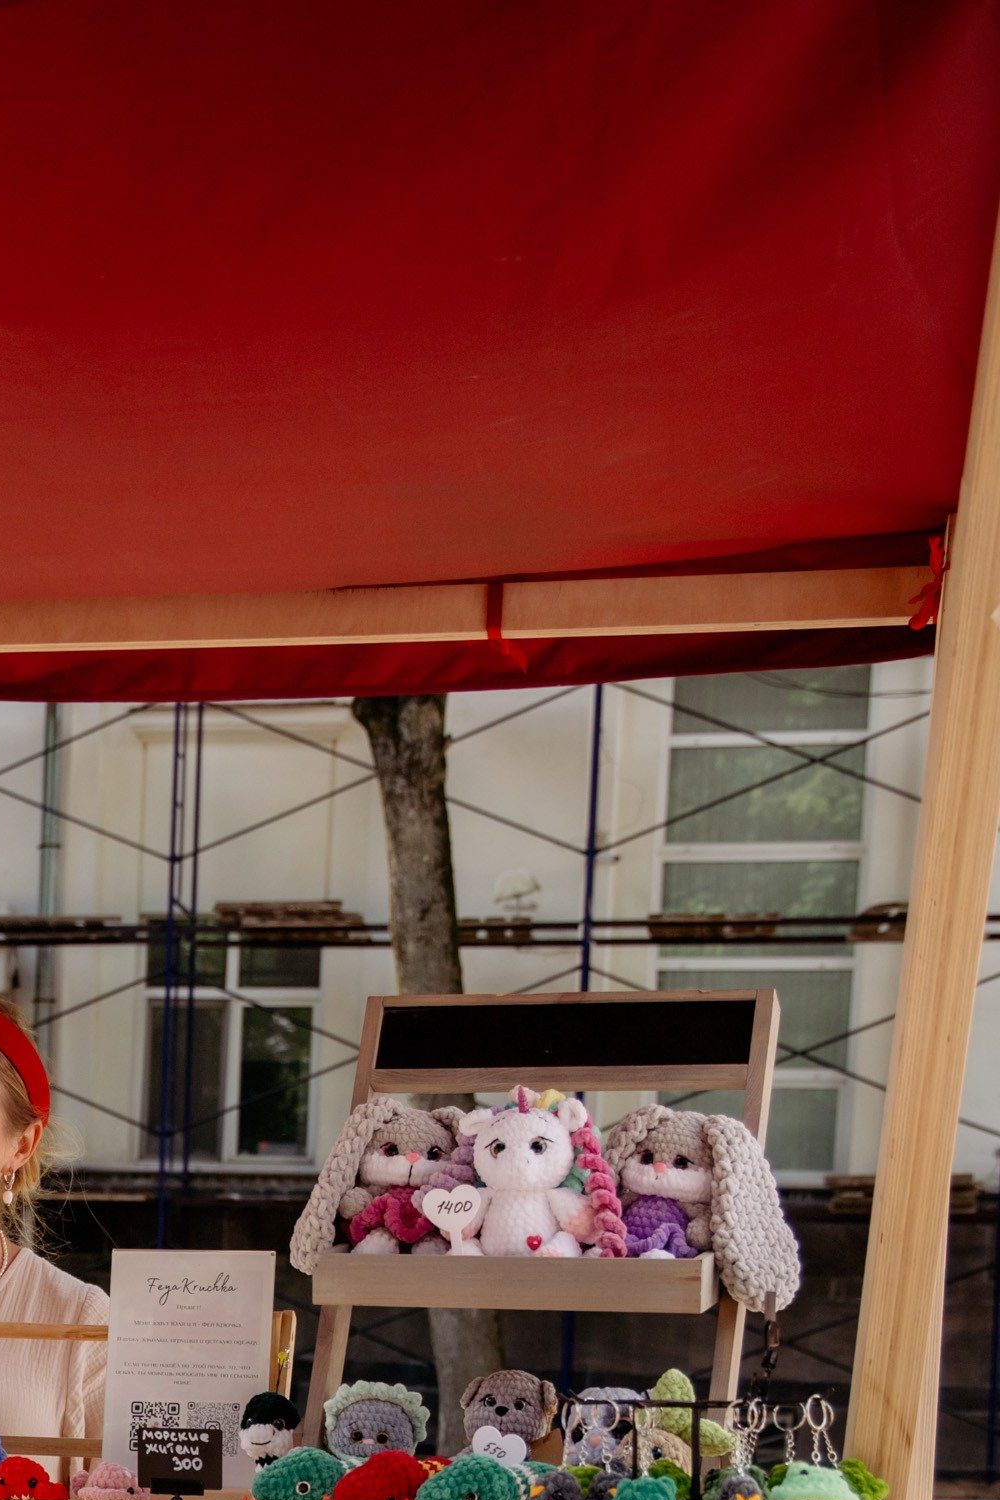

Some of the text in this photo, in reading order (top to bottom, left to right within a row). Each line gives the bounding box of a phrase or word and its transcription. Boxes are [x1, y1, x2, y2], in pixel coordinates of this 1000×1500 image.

[437, 1200, 473, 1215] 1400
[483, 1442, 507, 1459] 550
[172, 1457, 204, 1472] 300
